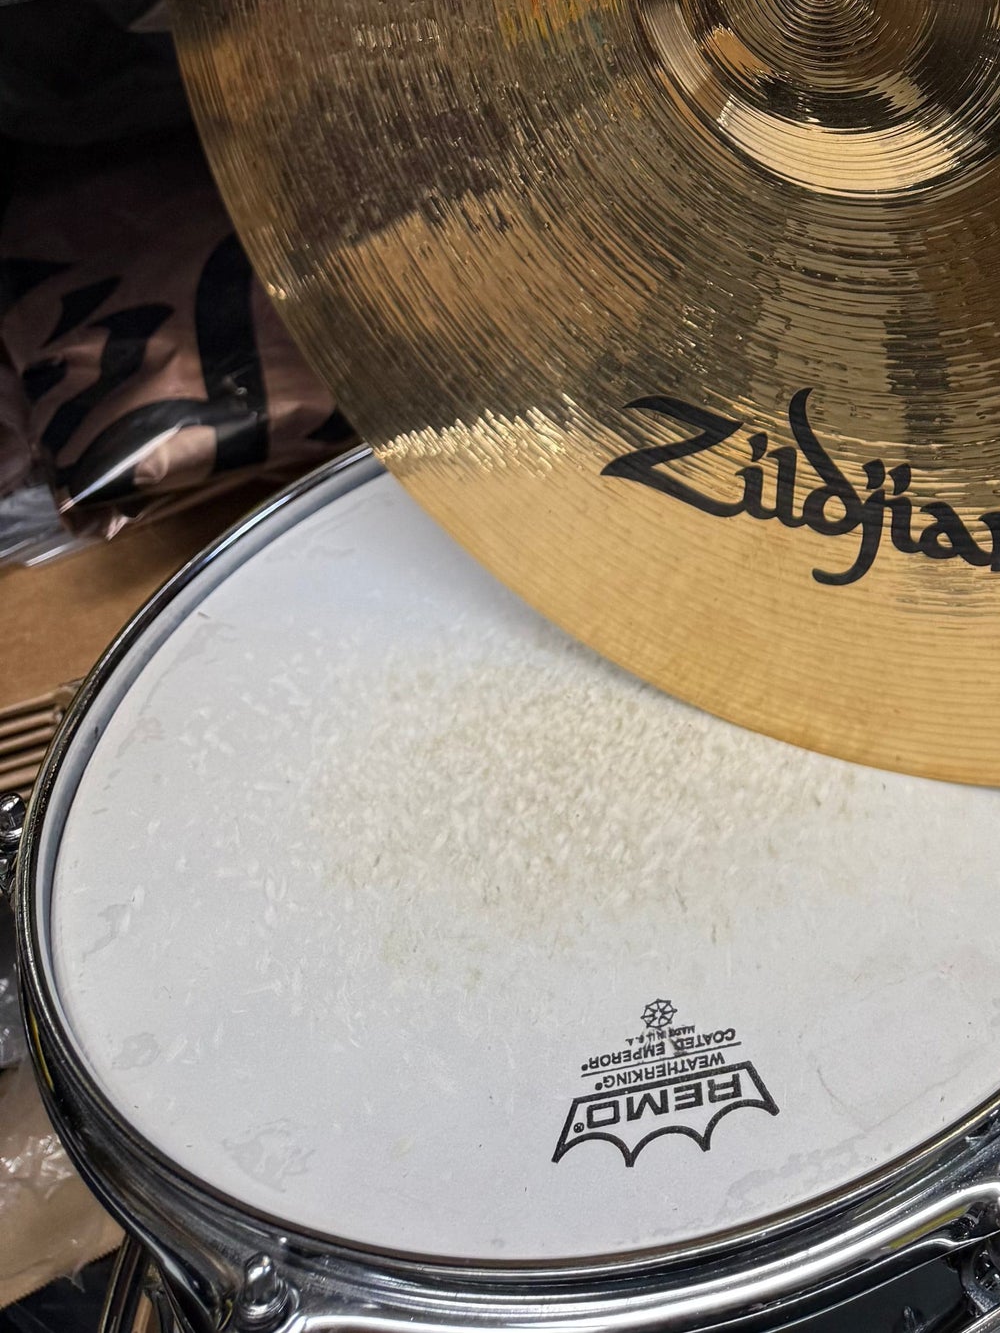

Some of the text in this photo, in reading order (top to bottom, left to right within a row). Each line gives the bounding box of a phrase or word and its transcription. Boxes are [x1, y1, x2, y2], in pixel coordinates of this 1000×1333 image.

[588, 1027, 736, 1068] COATED EMPEROR
[602, 1051, 725, 1090] WEATHERKING
[586, 1073, 742, 1130] REMO
